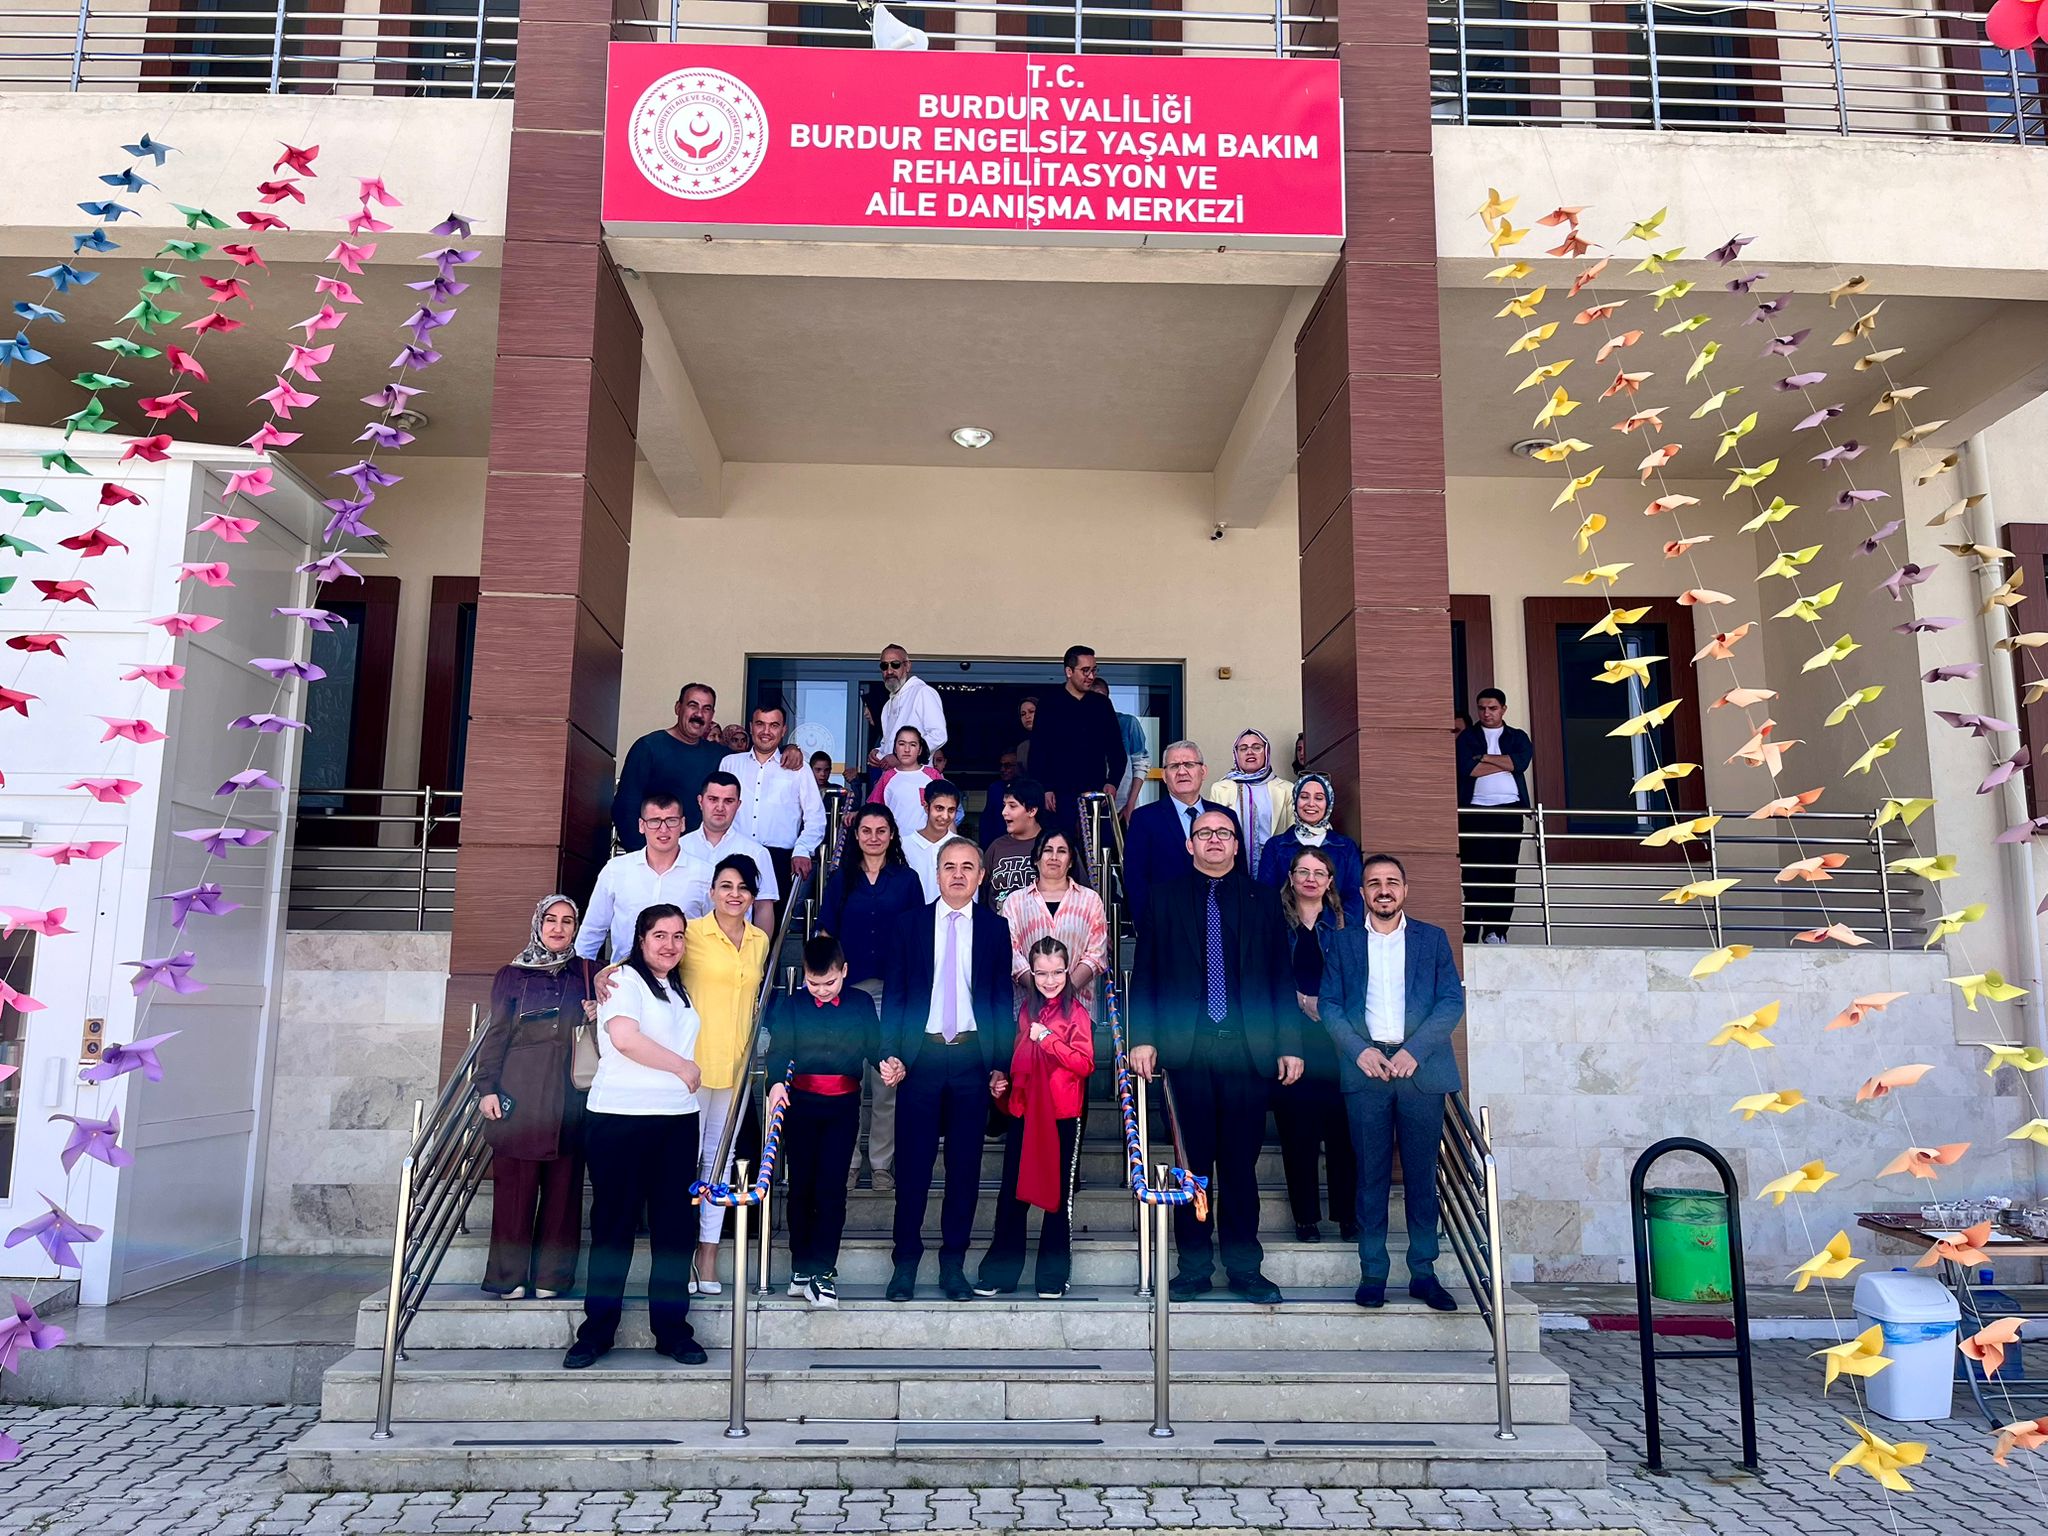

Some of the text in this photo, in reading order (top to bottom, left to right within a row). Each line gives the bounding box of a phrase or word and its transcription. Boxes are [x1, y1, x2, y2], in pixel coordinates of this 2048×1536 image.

[1026, 64, 1084, 88] T.C.
[701, 94, 727, 109] SOSYAL
[919, 94, 1191, 123] BURDUR VALİLİĞİ
[791, 124, 1318, 162] BURDUR ENGELSİZ YAŞAM BAKIM
[893, 158, 1217, 189] REHABİLİTASYON VE
[865, 188, 1244, 226] AİLE DANIŞMA MERKEZİ
[993, 856, 1033, 873] STA
